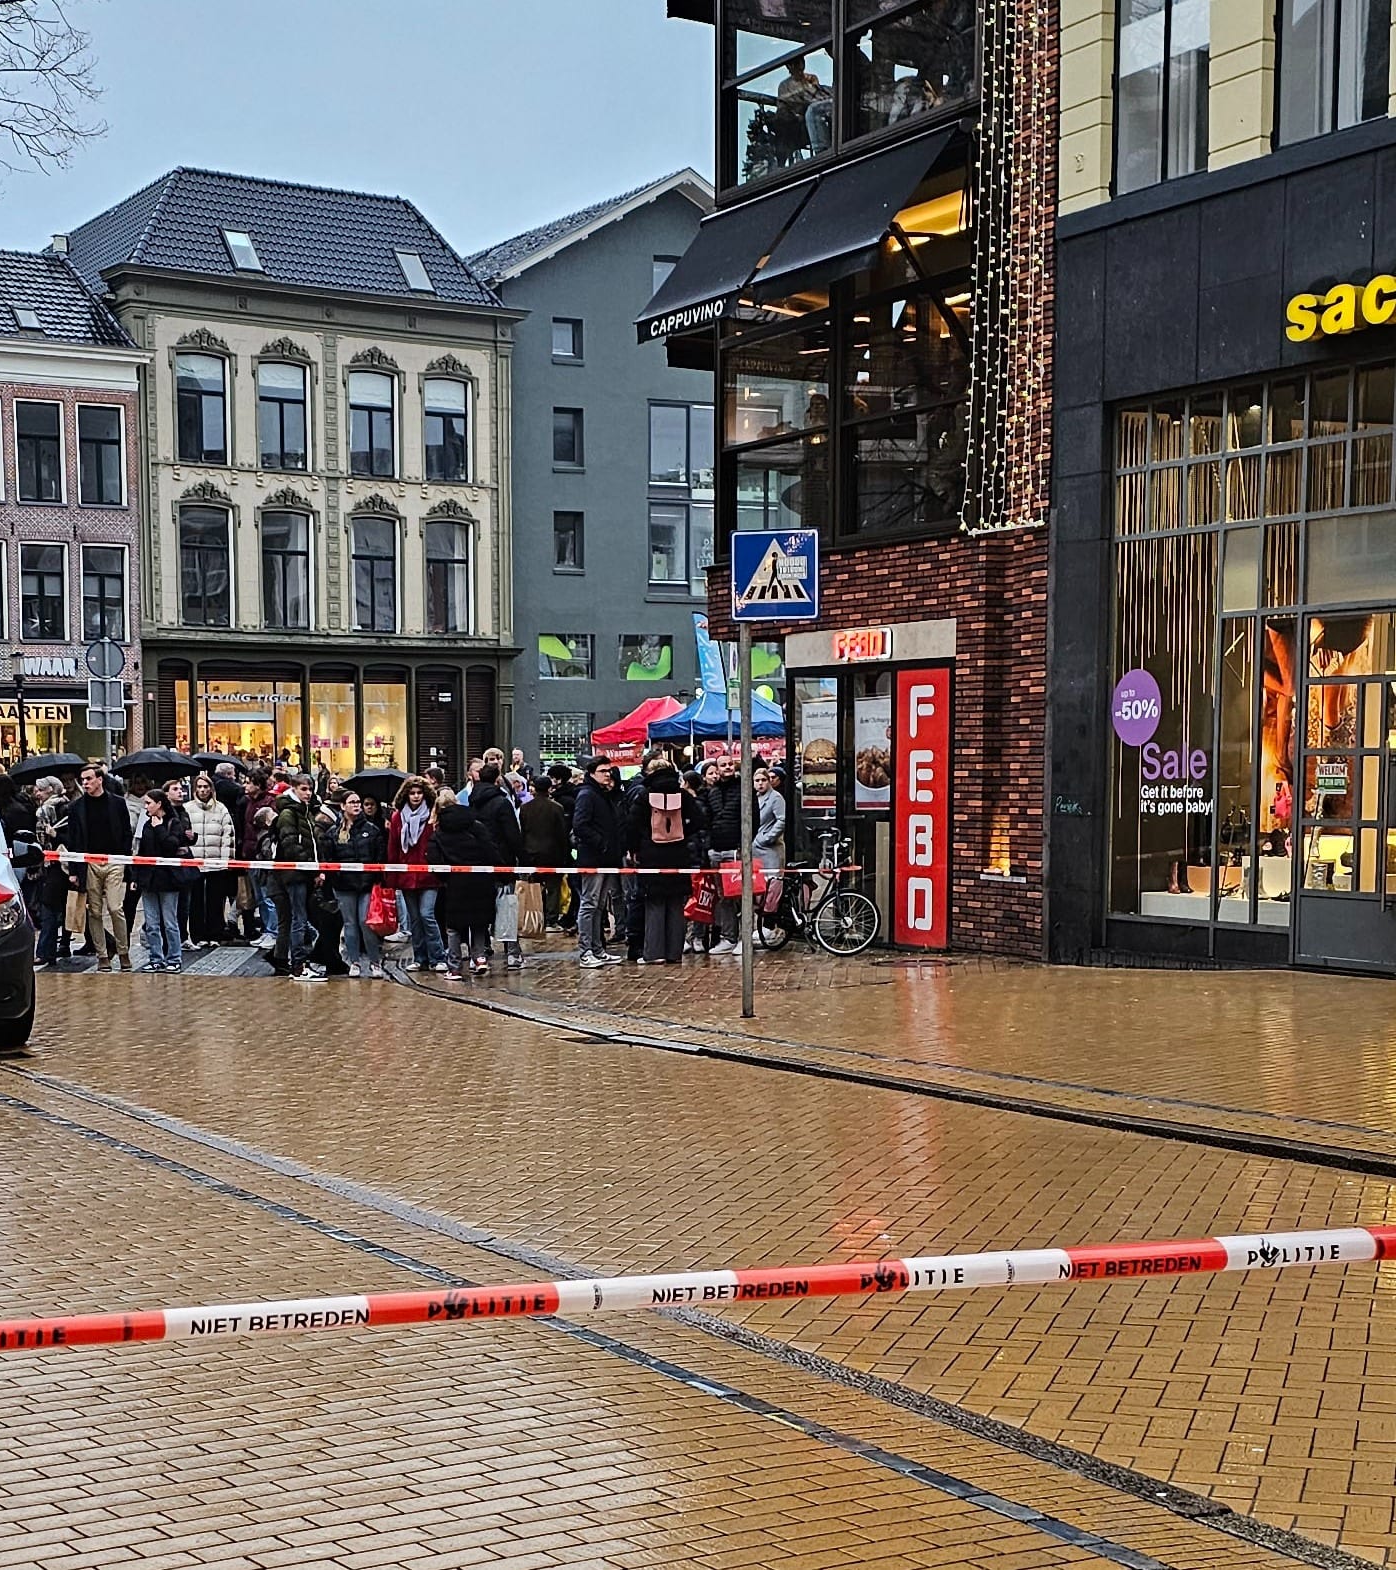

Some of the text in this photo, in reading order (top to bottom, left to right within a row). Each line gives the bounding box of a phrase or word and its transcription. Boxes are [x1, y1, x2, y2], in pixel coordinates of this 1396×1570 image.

[23, 656, 76, 678] WAAR
[1121, 689, 1136, 699] up to
[1115, 698, 1158, 721] -50%
[1142, 742, 1208, 780] Sale
[1141, 785, 1204, 798] Get it before
[908, 684, 935, 931] FEBO
[1141, 800, 1213, 816] it's gone baby!
[1059, 1255, 1202, 1279] NIET BETREDEN
[651, 1280, 809, 1304] NIET BETREDEN
[190, 1308, 370, 1335] NIET BETREDEN
